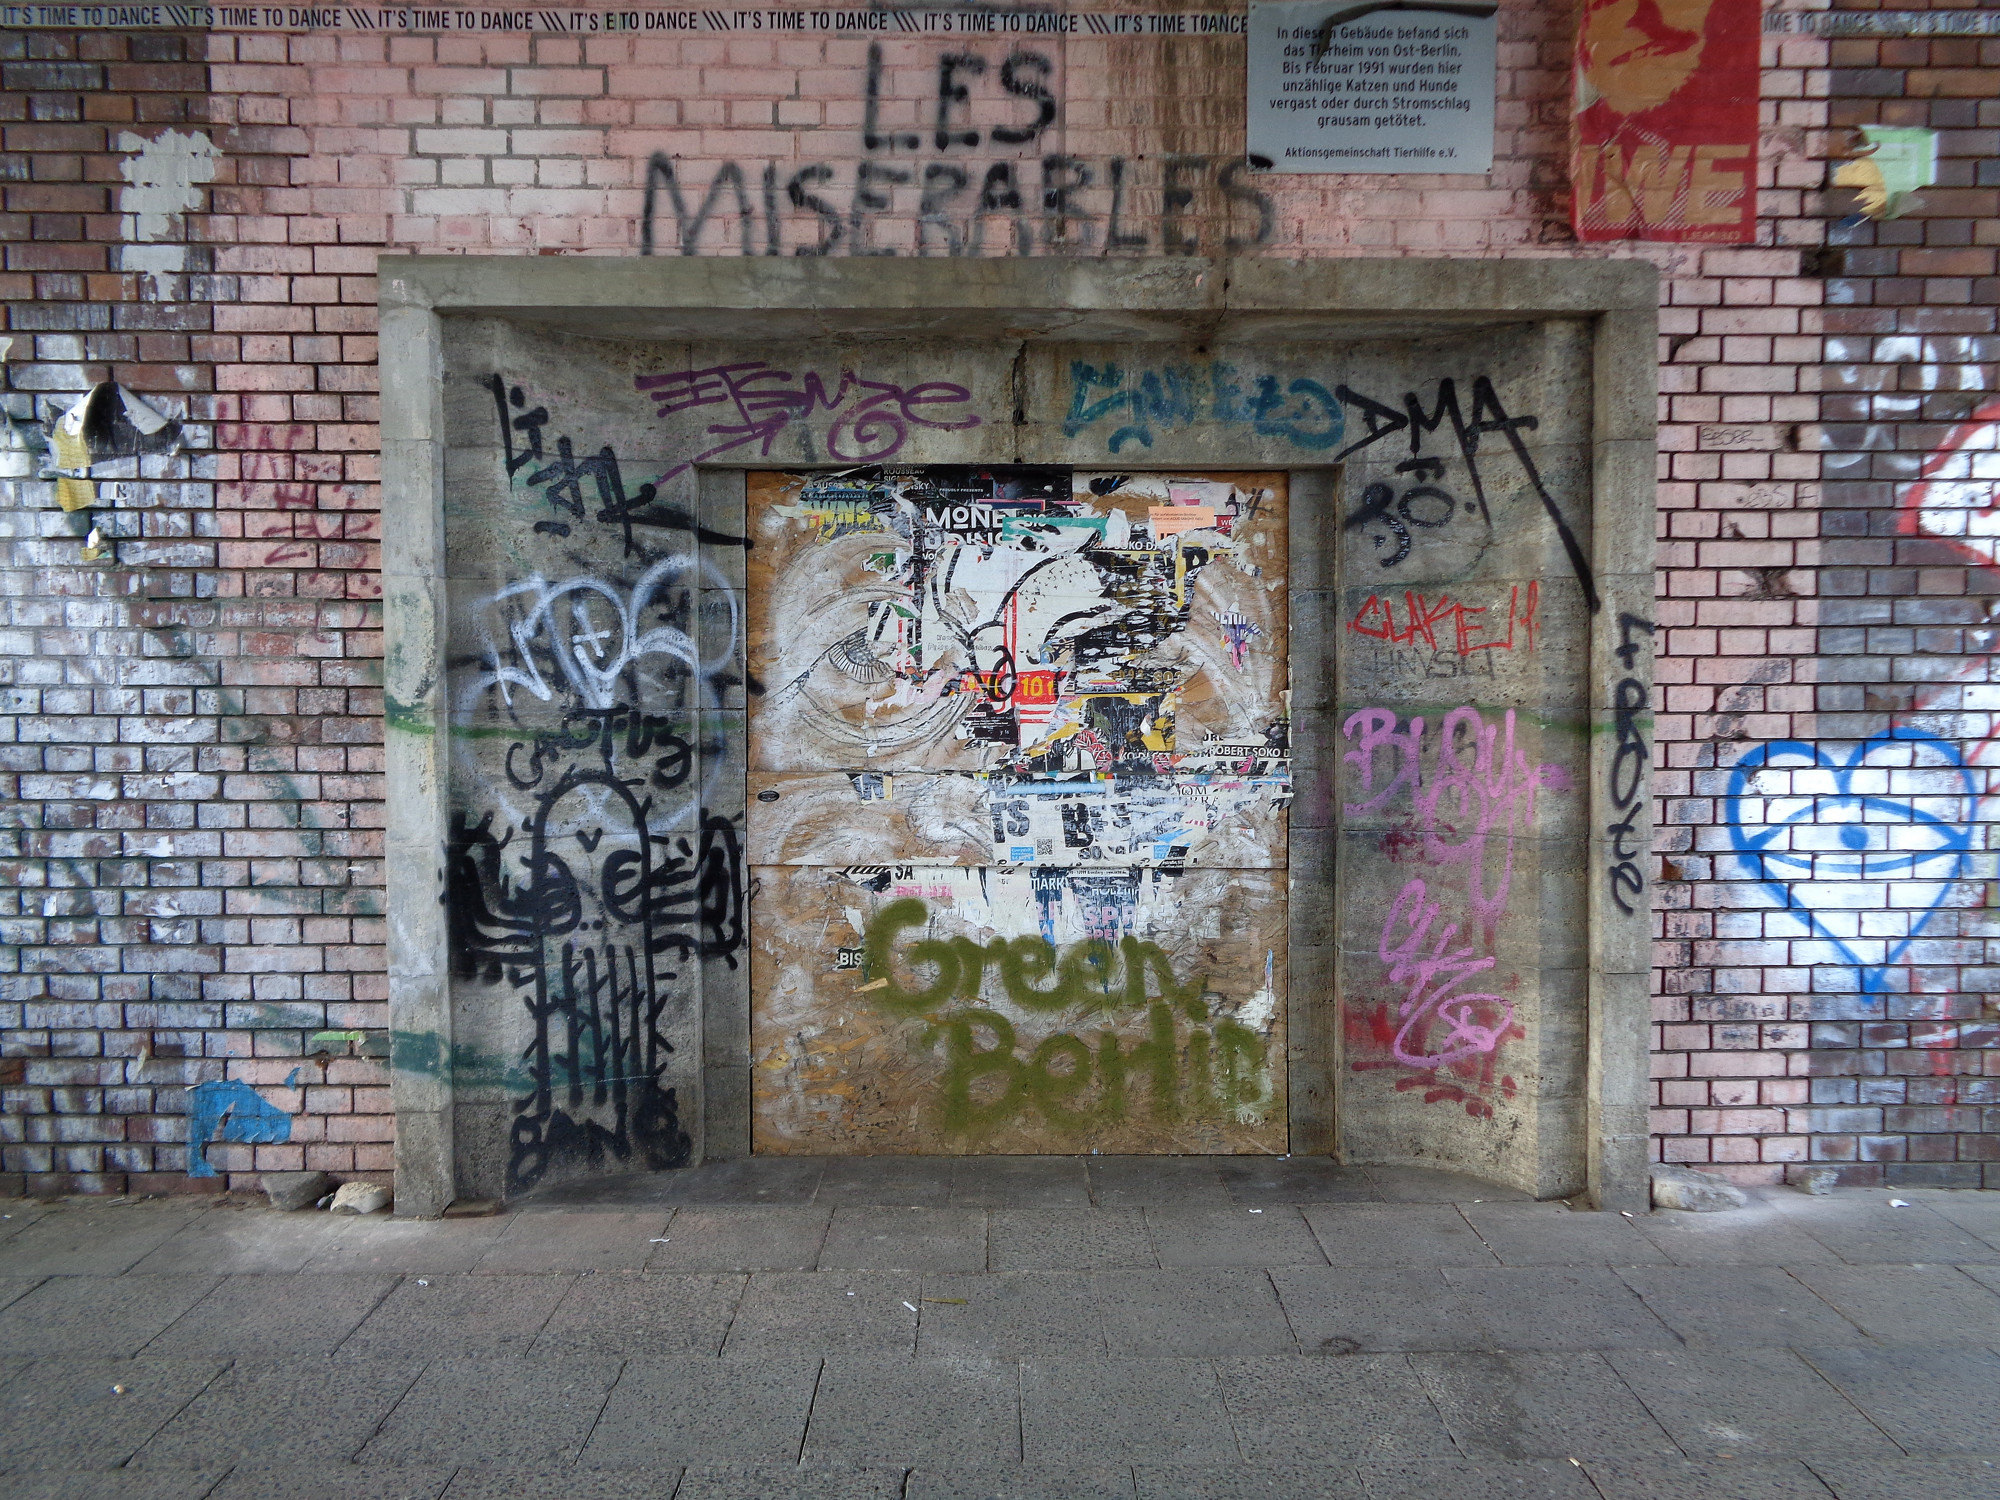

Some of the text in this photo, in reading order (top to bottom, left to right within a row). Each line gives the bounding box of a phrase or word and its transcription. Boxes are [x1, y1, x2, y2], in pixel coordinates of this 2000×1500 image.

[3, 7, 161, 25] IT'S TIME TO DANCE
[219, 8, 257, 26] TIME
[262, 9, 284, 26] TO
[289, 9, 341, 27] DANCE
[378, 10, 533, 29] IT'S TIME TO DANCE
[569, 12, 598, 30] IT'S
[619, 12, 639, 30] TO
[645, 12, 698, 30] DANCE
[733, 11, 888, 30] IT'S TIME TO DANCE
[923, 13, 1078, 32] IT'S TIME TO DANCE
[1114, 14, 1143, 33] IT'S
[1148, 14, 1186, 33] TIME
[1277, 26, 1288, 40] In
[1341, 25, 1395, 40] Gebäude
[1398, 25, 1440, 40] befand
[1444, 25, 1469, 40] sich
[1284, 44, 1304, 56] das
[1368, 46, 1389, 56] von
[1283, 60, 1462, 74] Bis Februar 1991 wurden hier
[1283, 78, 1458, 93] unzählige Katzen und Hunde
[1270, 97, 1471, 112] vergast oder durch Stromschlag
[1317, 114, 1426, 128] grausam getötet.
[1285, 147, 1458, 160] Aktionsgemeinschaft Tierhilfe e.V.
[1209, 746, 1249, 758] ROBERT
[1252, 748, 1281, 758] SOKO
[839, 952, 863, 966] BIS
[866, 897, 1209, 1012] Green
